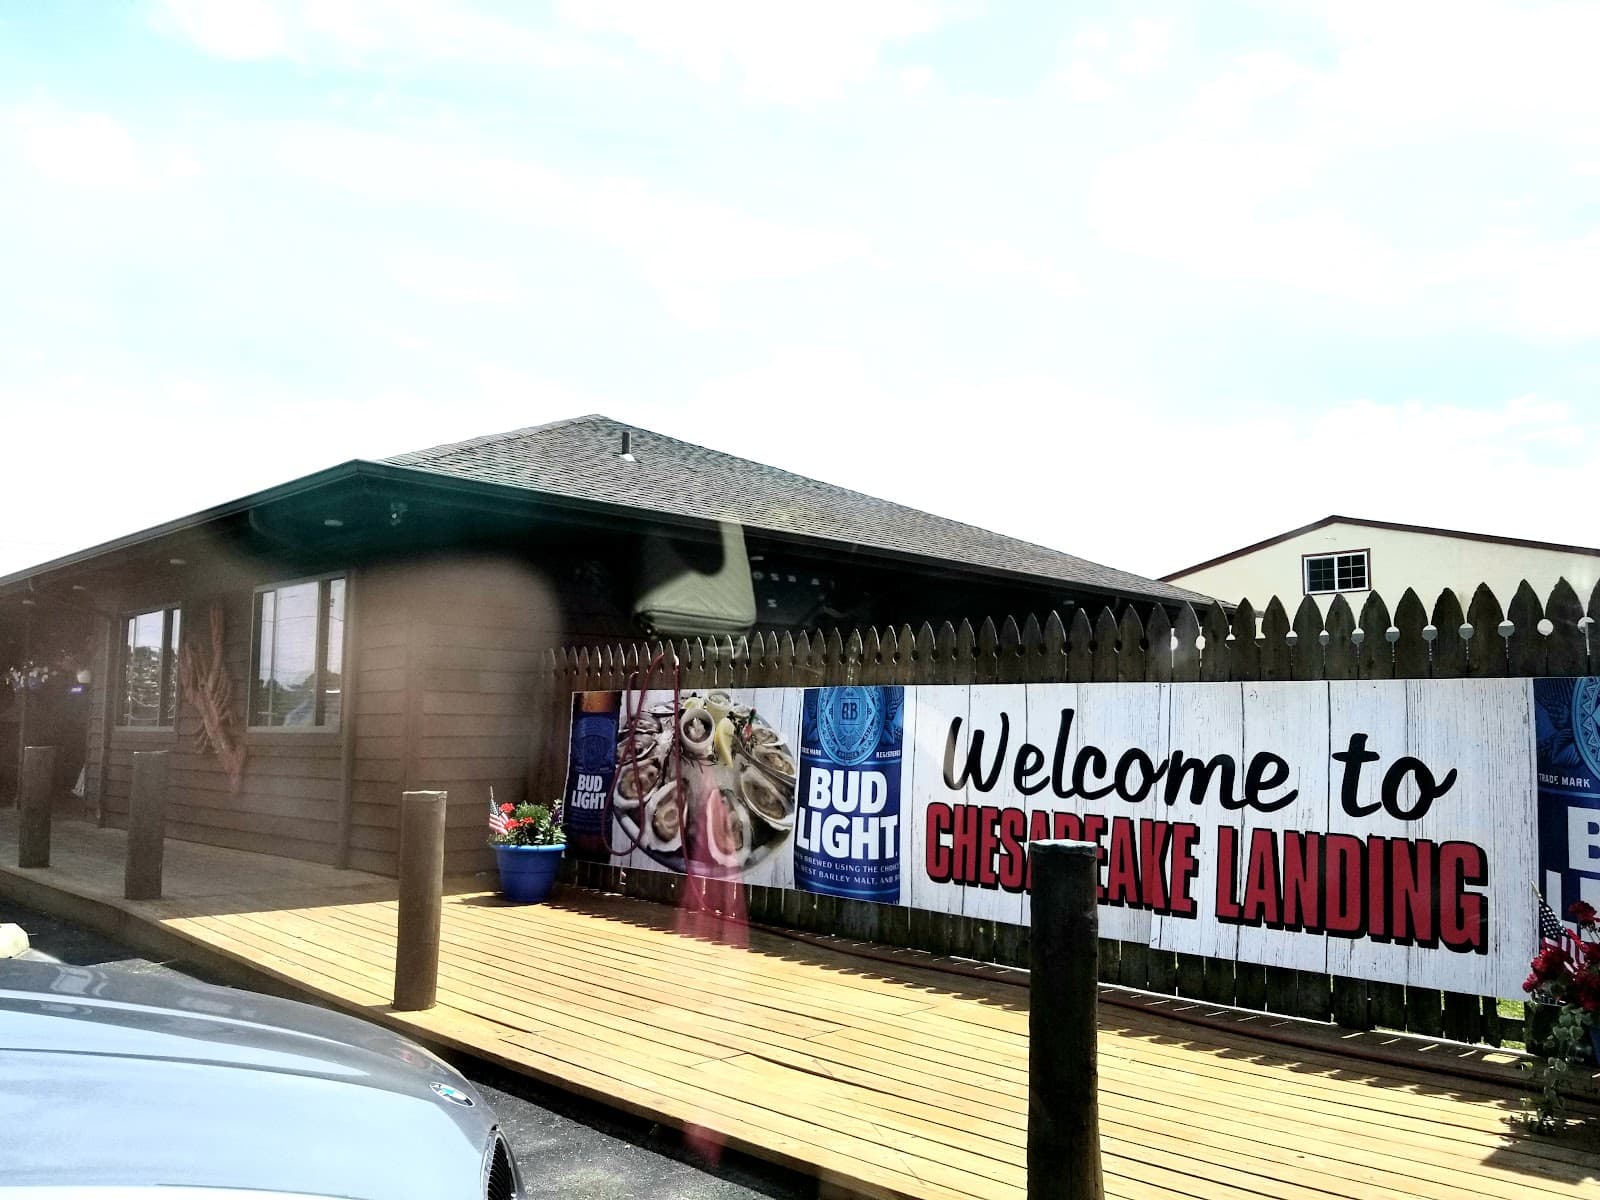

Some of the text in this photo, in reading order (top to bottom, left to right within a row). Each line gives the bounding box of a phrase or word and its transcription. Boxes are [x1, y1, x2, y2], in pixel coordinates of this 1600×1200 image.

[942, 708, 1458, 821] Welcome to
[577, 774, 603, 792] BUD
[1538, 772, 1591, 788] TRADE MARK
[571, 790, 607, 810] LIGHT
[808, 767, 888, 814] BUD
[796, 807, 899, 860] LIGHT
[803, 855, 833, 869] BREWED
[834, 862, 861, 873] USING
[862, 865, 879, 873] THE
[818, 870, 850, 883] BARLEY
[1215, 825, 1490, 956] LANDING
